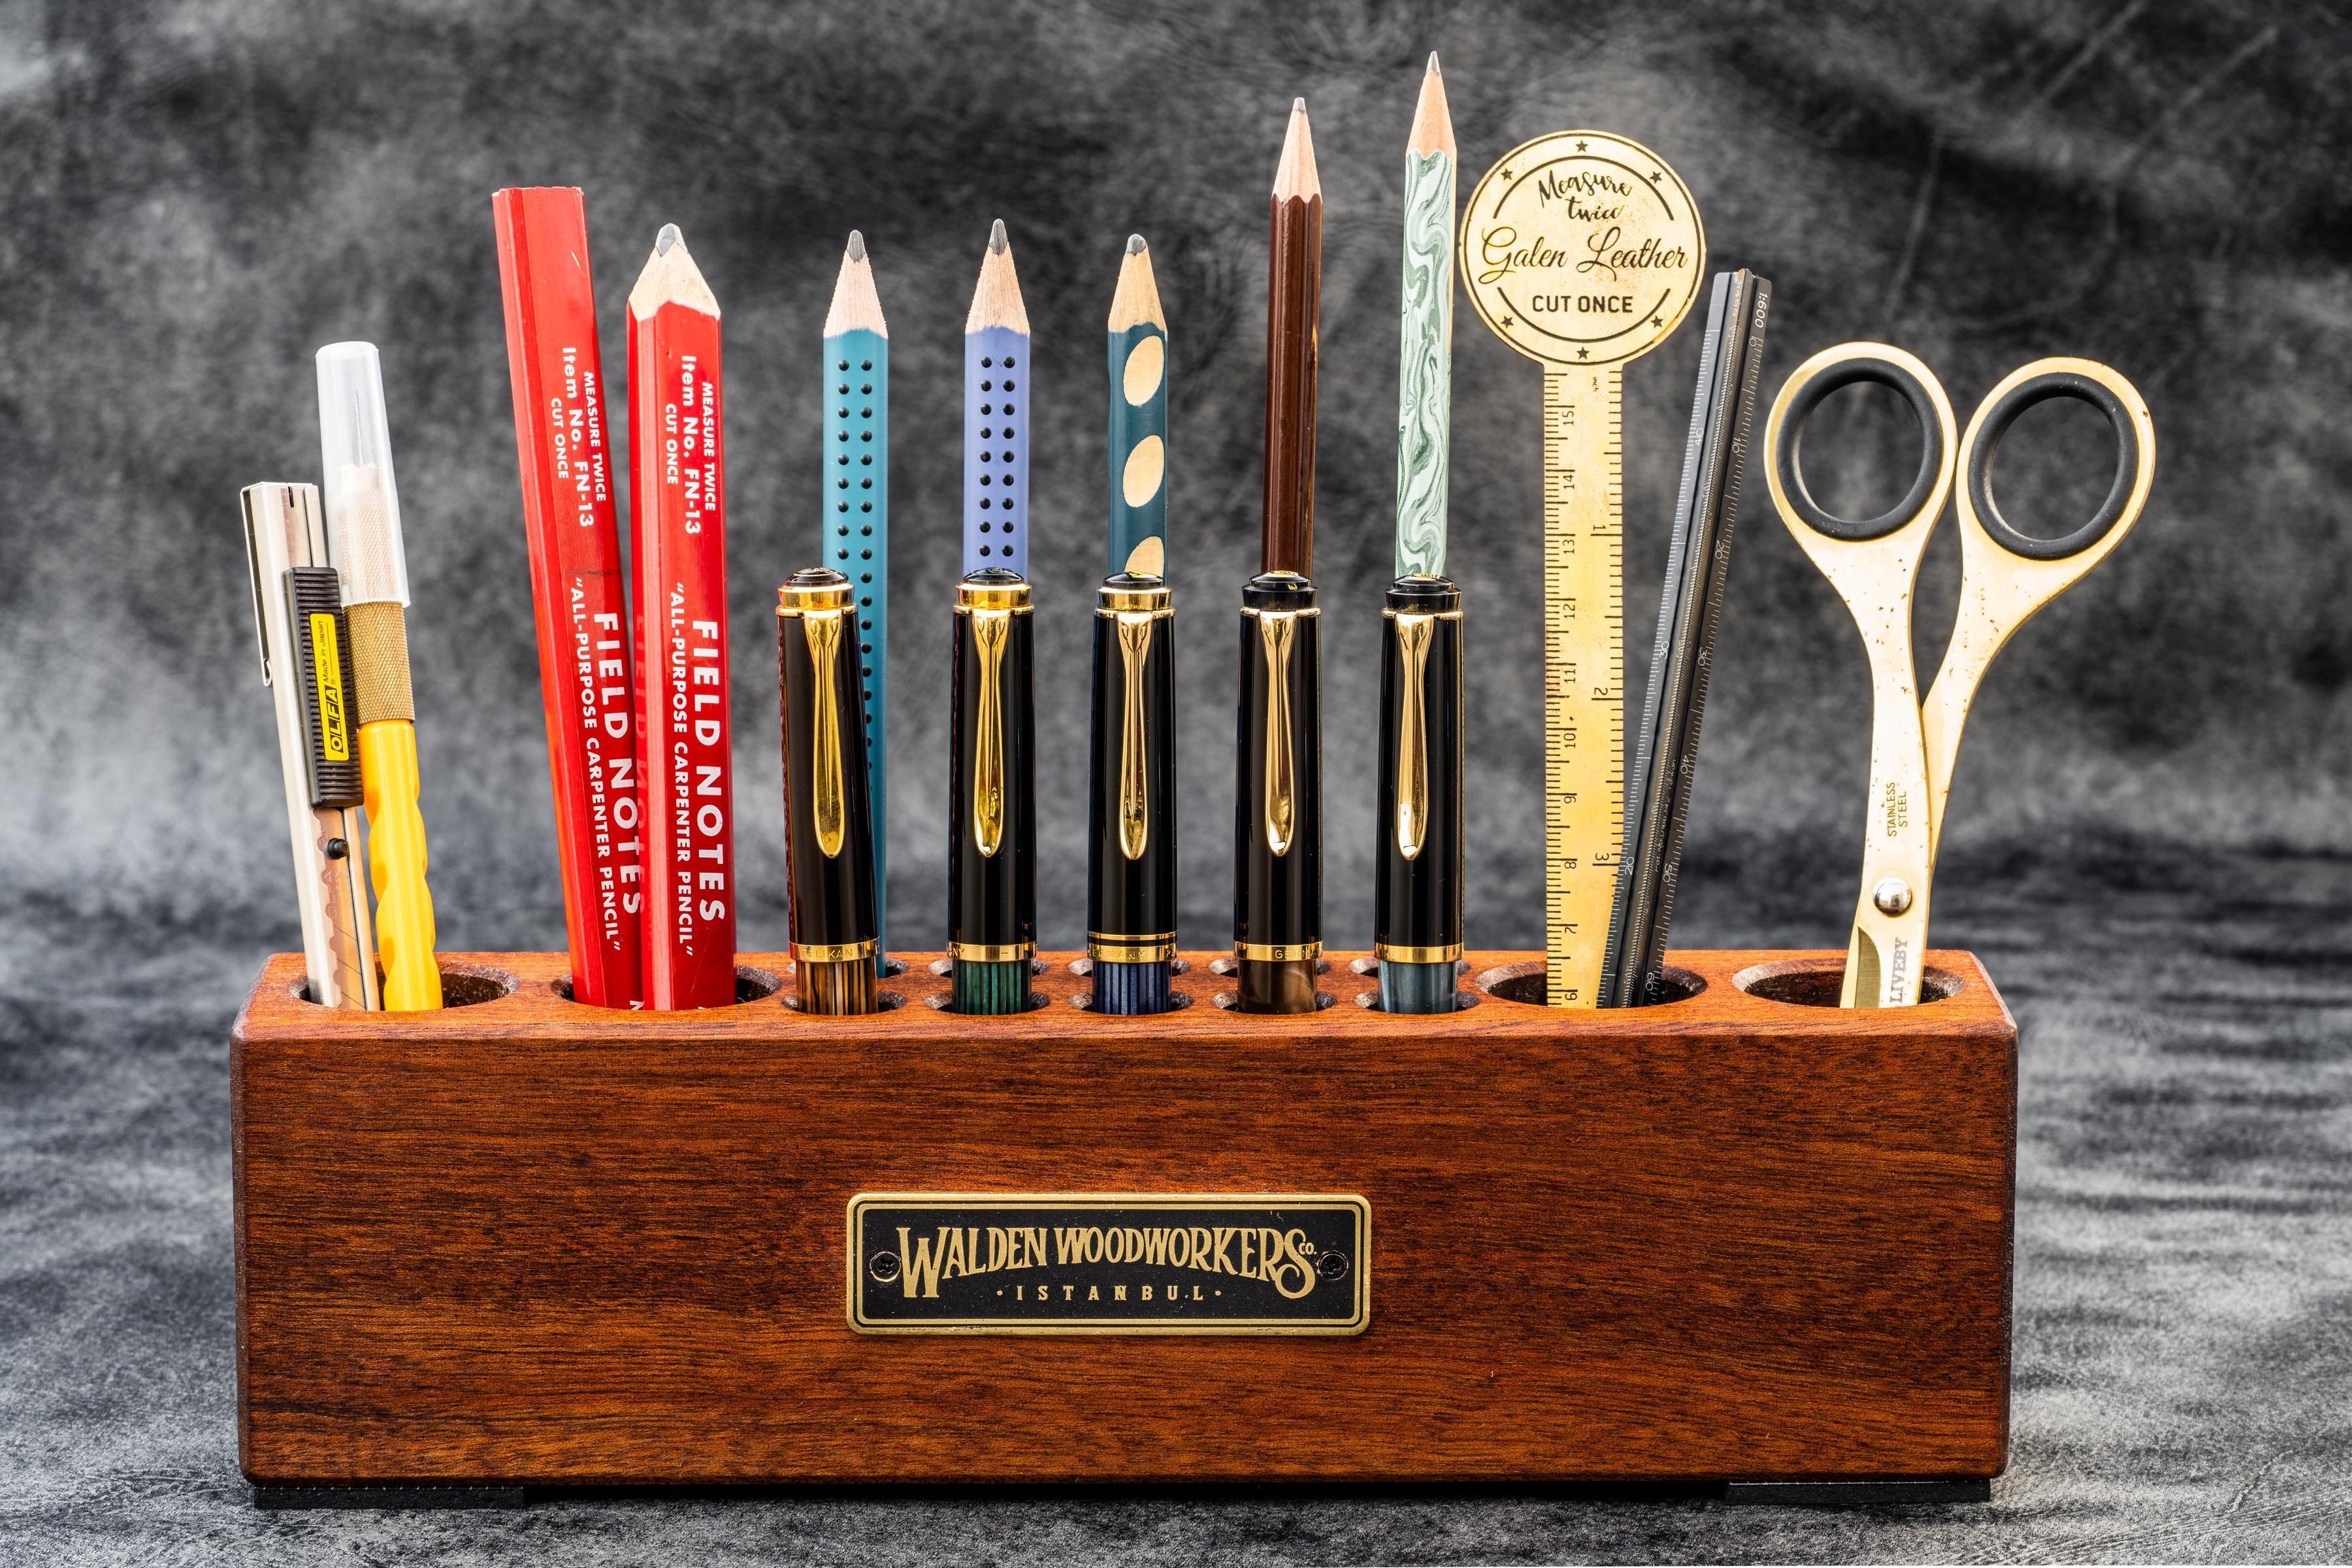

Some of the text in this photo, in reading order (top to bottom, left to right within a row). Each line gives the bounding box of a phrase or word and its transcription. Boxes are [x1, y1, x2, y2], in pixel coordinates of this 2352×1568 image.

[1539, 170, 1632, 208] Measure
[1565, 196, 1624, 222] twice
[1478, 226, 1688, 284] Galen Leather
[1532, 295, 1633, 313] CUT ONCE
[1755, 292, 1768, 328] 1:600
[1562, 411, 1575, 425] 15
[551, 397, 569, 479] CUT ONCE
[563, 347, 594, 527] Item No. FN-13
[584, 371, 606, 502] MEASURE TWICE
[665, 403, 679, 485] CUT ONCE
[681, 355, 701, 534] Item No. FN-13
[702, 382, 716, 511] MEASURE TWICE
[1695, 427, 1704, 446] 40
[1563, 474, 1575, 490] 14
[1563, 539, 1575, 554] 13
[1715, 540, 1725, 560] 20
[1563, 604, 1576, 619] 12
[1659, 641, 1669, 659] 30
[1698, 647, 1708, 666] 30
[593, 613, 628, 738] FIELD
[1564, 669, 1576, 683] 11
[1563, 733, 1576, 748] 10
[693, 620, 725, 921] FIELD NOTES
[1680, 754, 1690, 774] 40
[586, 738, 610, 858] CARPENTER
[674, 742, 691, 862] CARPENTER
[1886, 782, 1897, 836] STAINLESS
[1899, 791, 1908, 827] STEEL
[609, 758, 640, 913] NOTES
[1564, 861, 1576, 870] 8
[1595, 853, 1609, 861] 3
[1625, 857, 1635, 875] 20
[1663, 863, 1673, 883] 50
[802, 948, 853, 959] PELIKAN
[1645, 972, 1655, 991] 60
[1890, 937, 1908, 1007] LIVEBY
[1565, 992, 1578, 1001] 6
[896, 1227, 1048, 1298] WALDEN
[1053, 1227, 1316, 1299] WOODWORKERS
[1017, 1285, 1203, 1301] ISTANBUL
